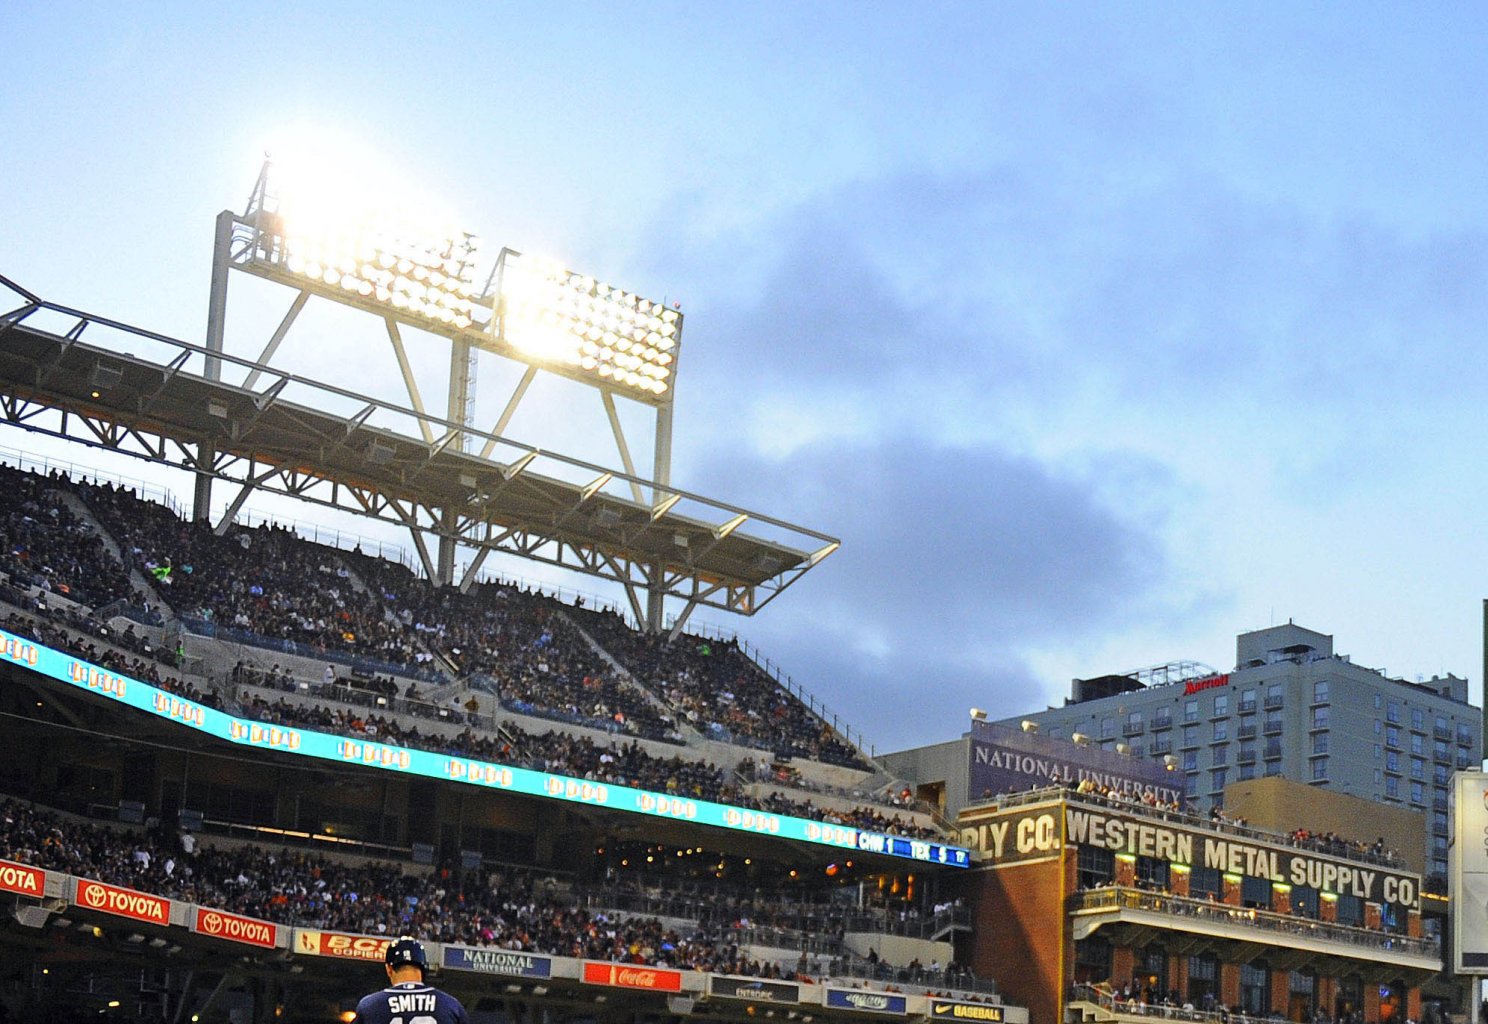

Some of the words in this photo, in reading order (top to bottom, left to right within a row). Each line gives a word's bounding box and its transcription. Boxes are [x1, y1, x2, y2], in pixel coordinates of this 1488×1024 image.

[975, 746, 1073, 782] NATIONAL
[1077, 768, 1181, 802] UNIVERSITY
[1017, 814, 1060, 854] CO.
[1066, 809, 1193, 864] WESTERN
[1204, 838, 1285, 882] METAL
[1290, 857, 1376, 899] SUPPLY
[1383, 876, 1418, 908] CO.
[108, 891, 163, 919] TOYOTA
[223, 917, 271, 944] TOYOTA
[463, 950, 534, 969] NATIONAL
[388, 994, 436, 1013] SMITH
[953, 1004, 1000, 1021] BASEBALL
